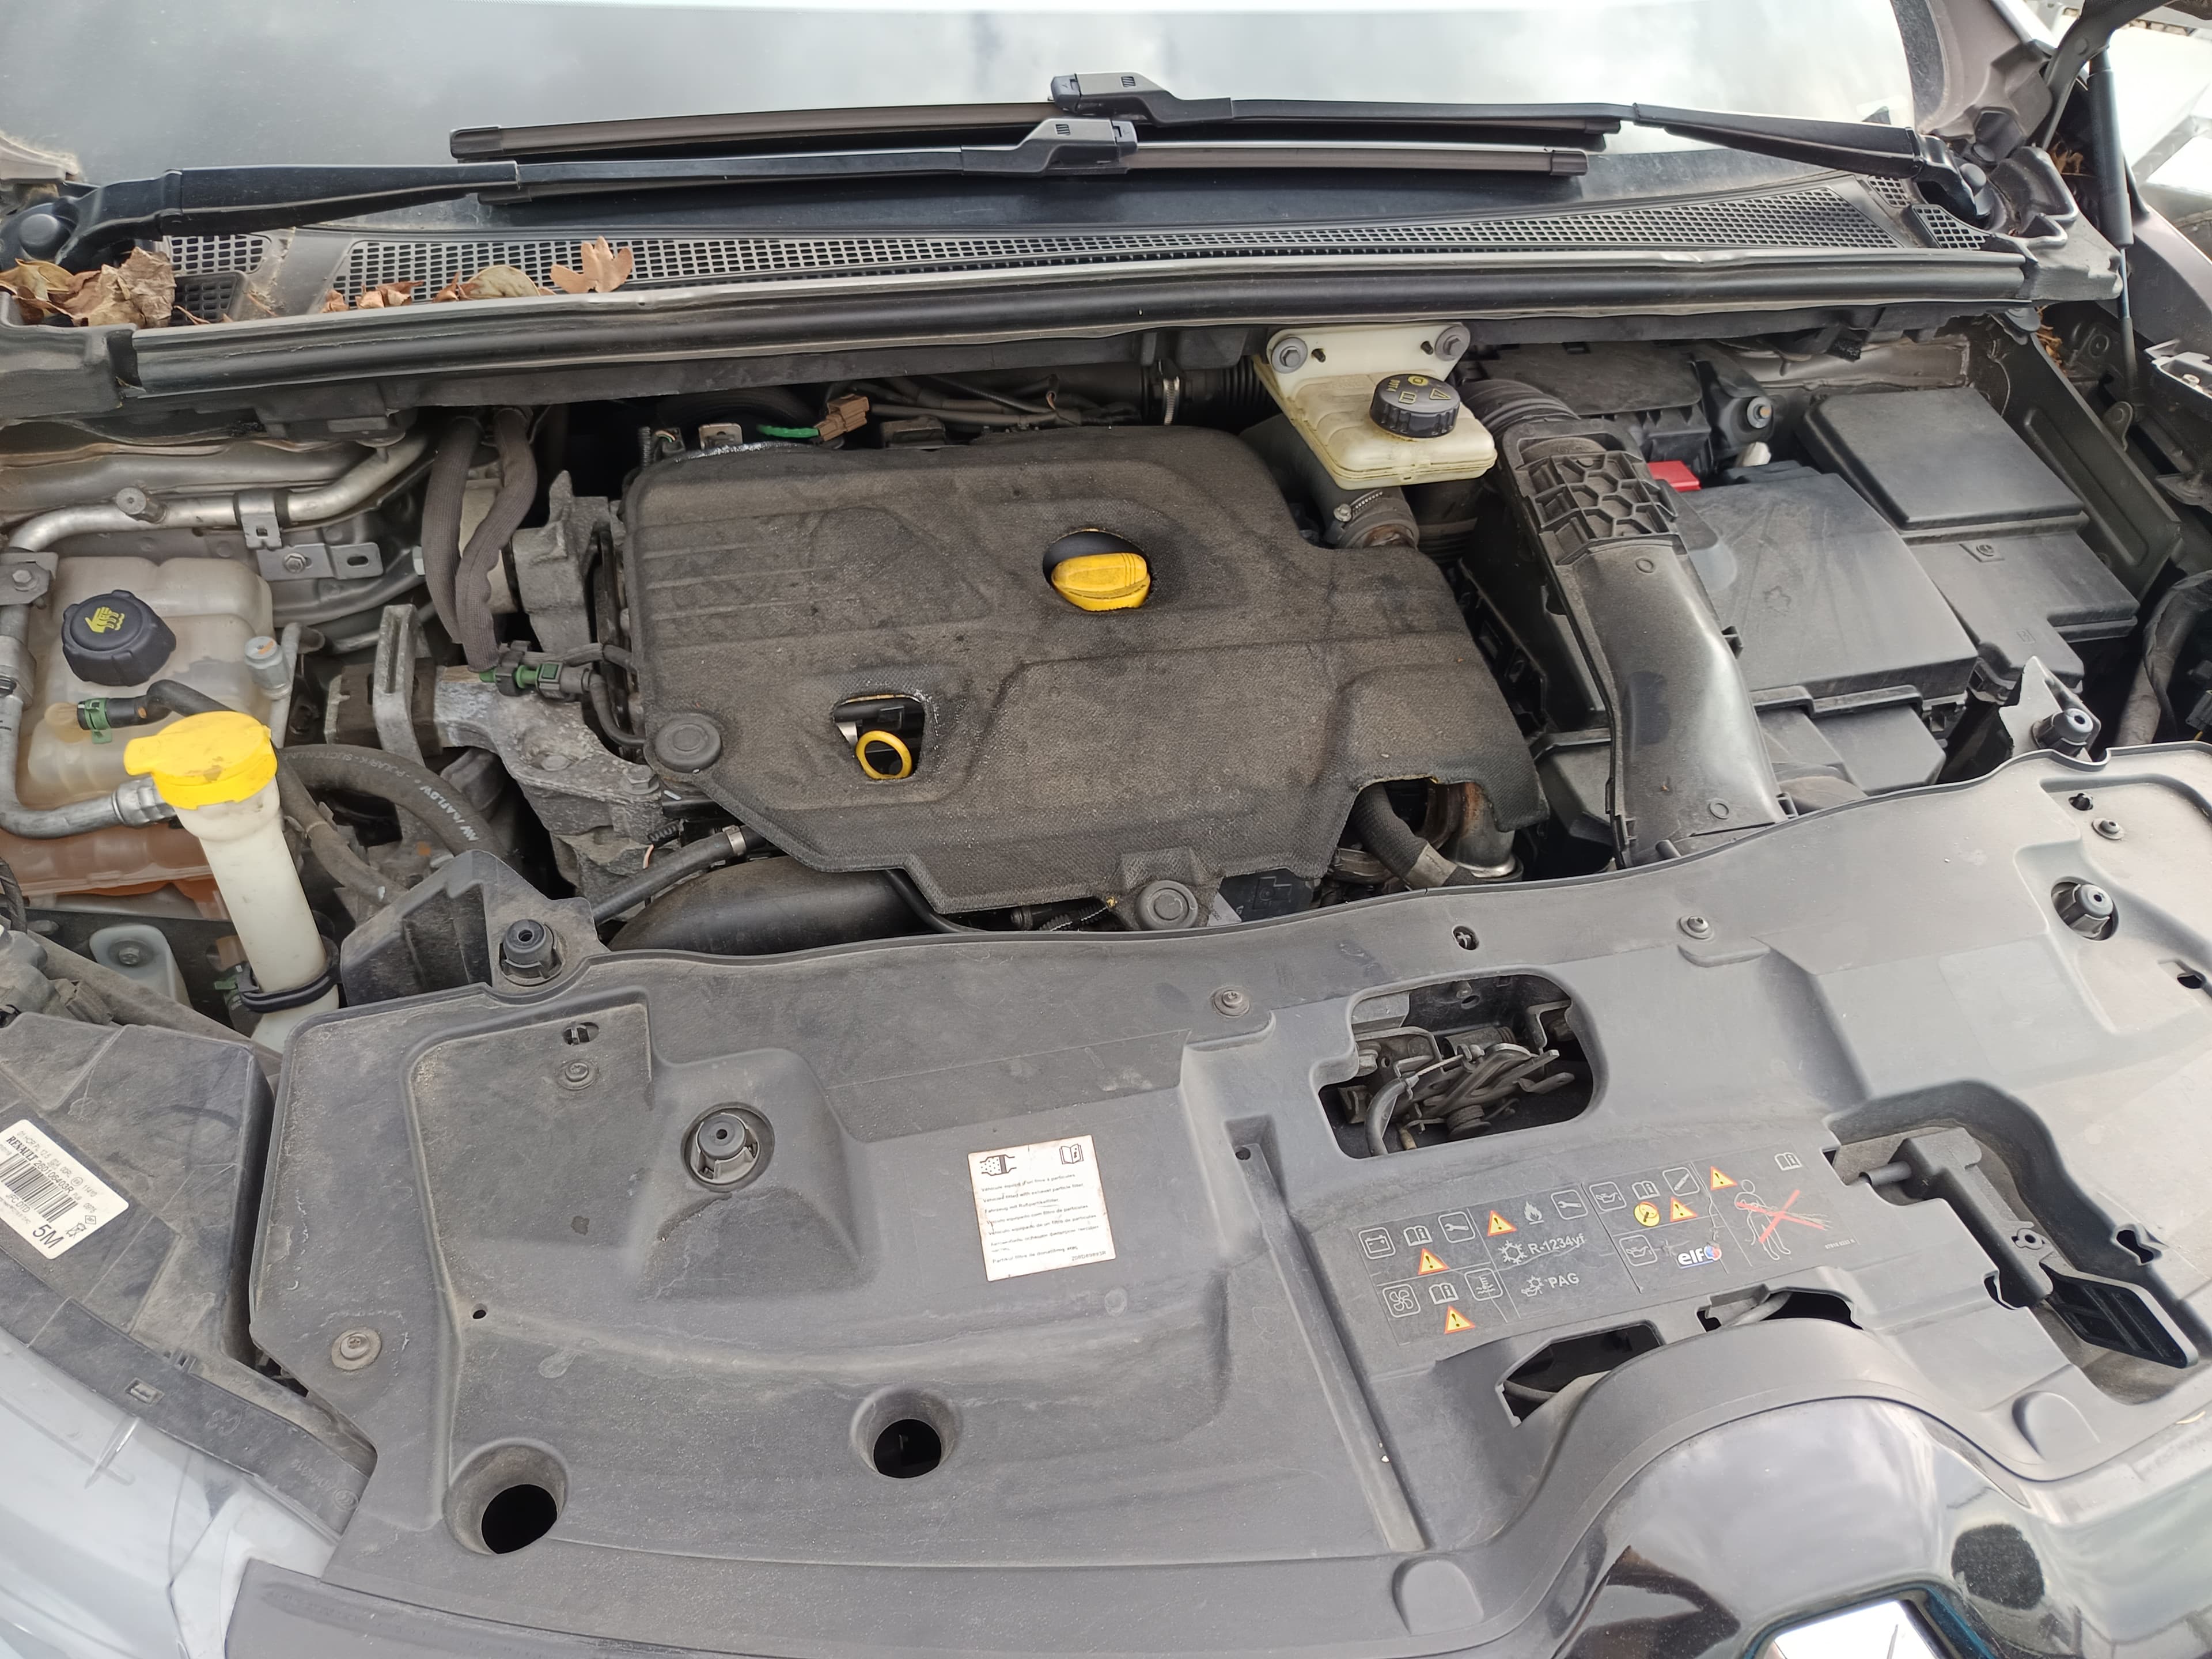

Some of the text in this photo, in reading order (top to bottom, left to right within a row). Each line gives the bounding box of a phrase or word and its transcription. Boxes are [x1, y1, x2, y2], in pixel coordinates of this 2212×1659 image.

[6, 1135, 39, 1161] RENAULT
[32, 1224, 65, 1249] 5M
[1528, 1232, 1586, 1254] R-1234yf
[1677, 1249, 1706, 1266] elf
[1549, 1273, 1580, 1289] PAG
